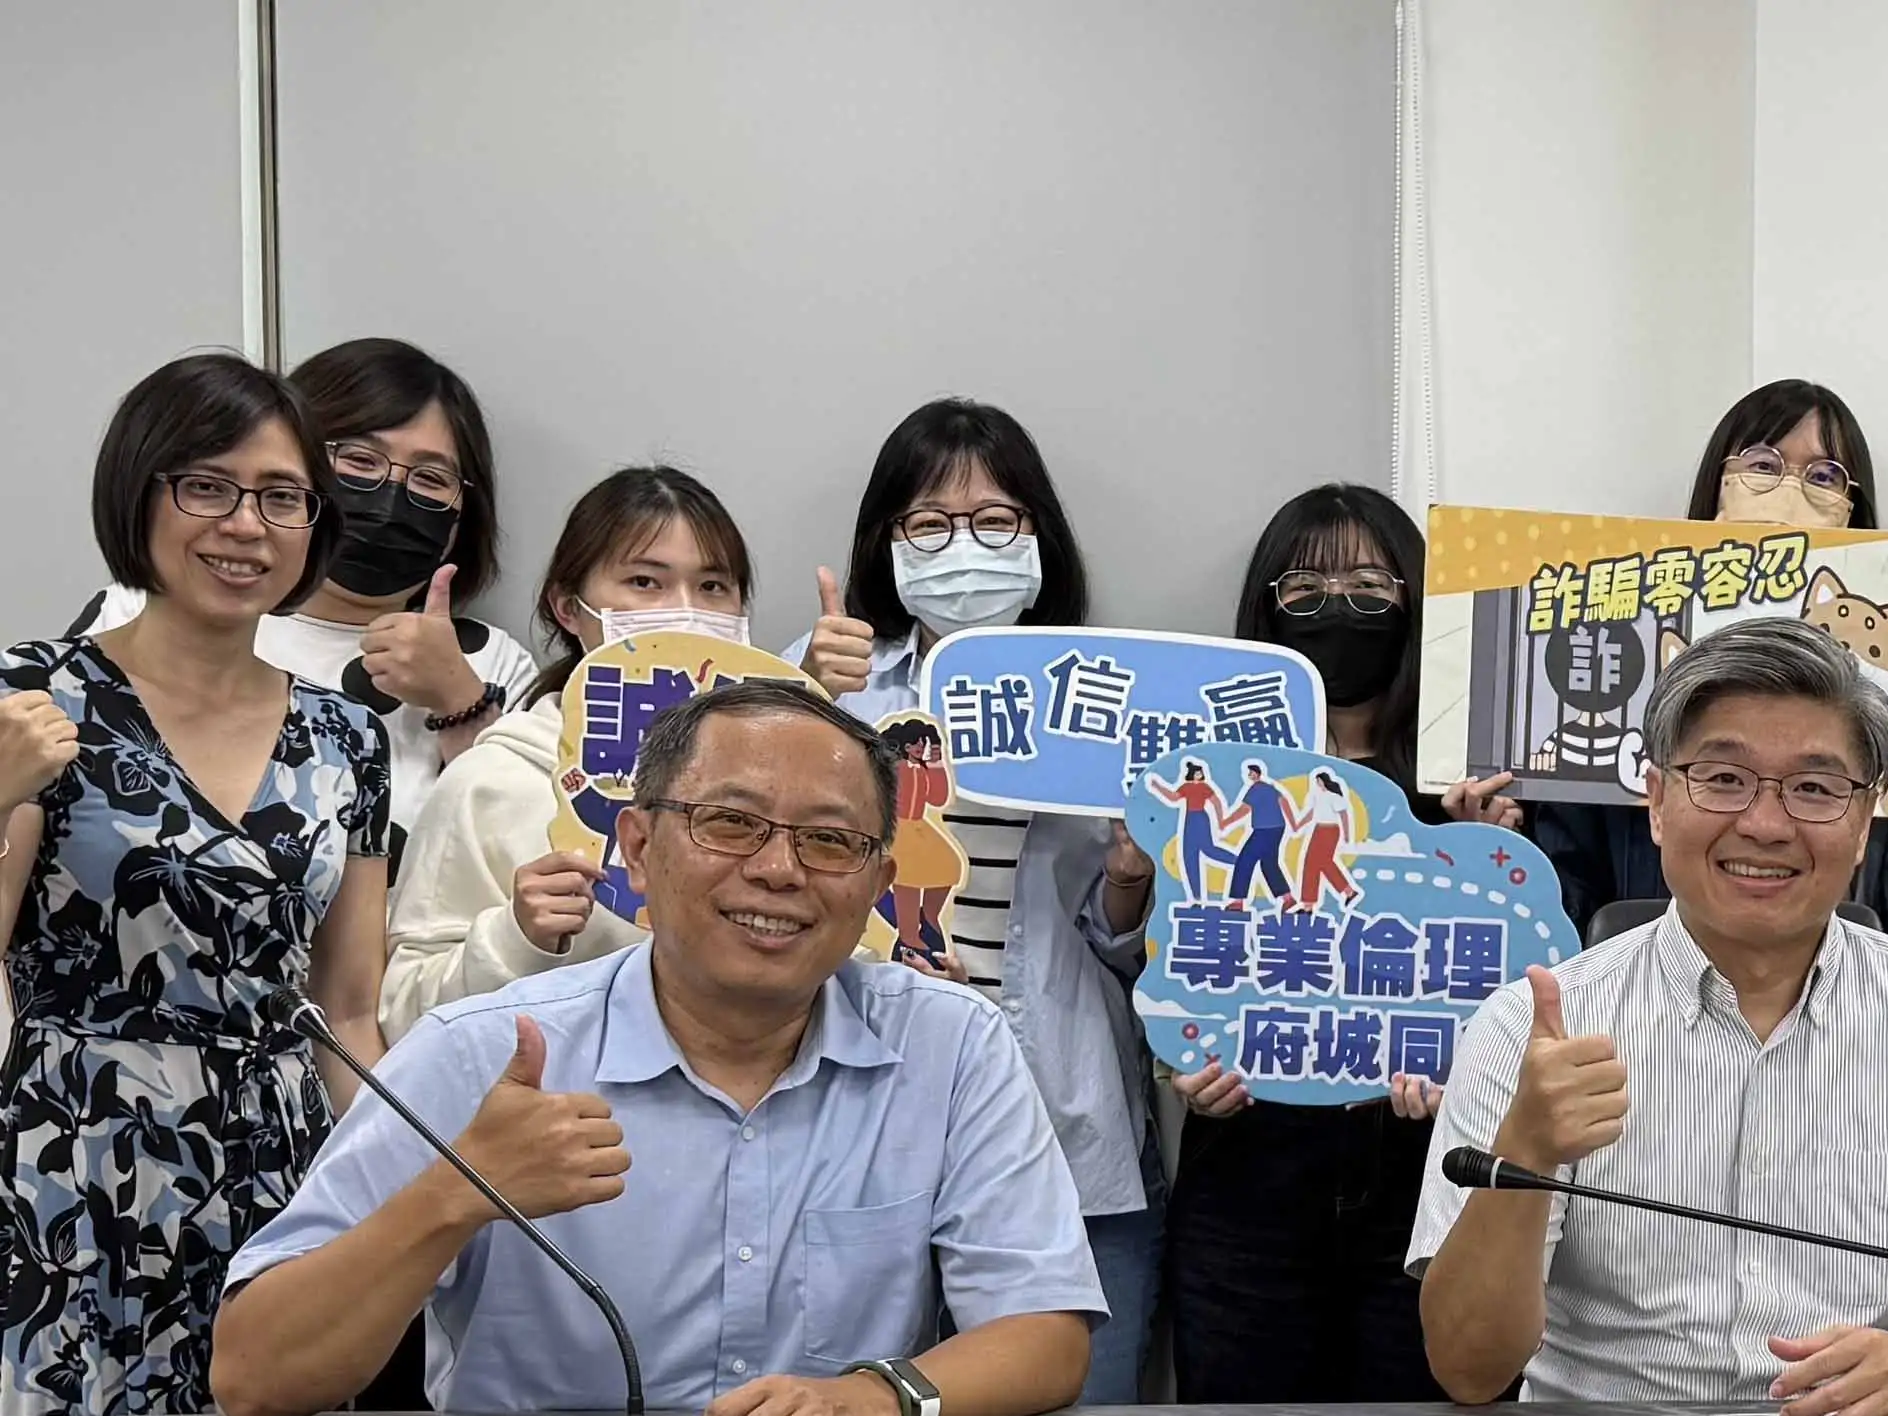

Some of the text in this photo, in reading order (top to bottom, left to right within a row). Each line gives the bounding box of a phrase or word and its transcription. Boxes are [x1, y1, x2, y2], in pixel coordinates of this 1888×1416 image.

[1526, 530, 1808, 634] 詐騙零容忍
[1567, 627, 1623, 694] 詐
[946, 655, 1298, 791] 誠信雙贏
[1170, 905, 1508, 1003] 專業倫理
[1239, 1007, 1467, 1085] 府城同
